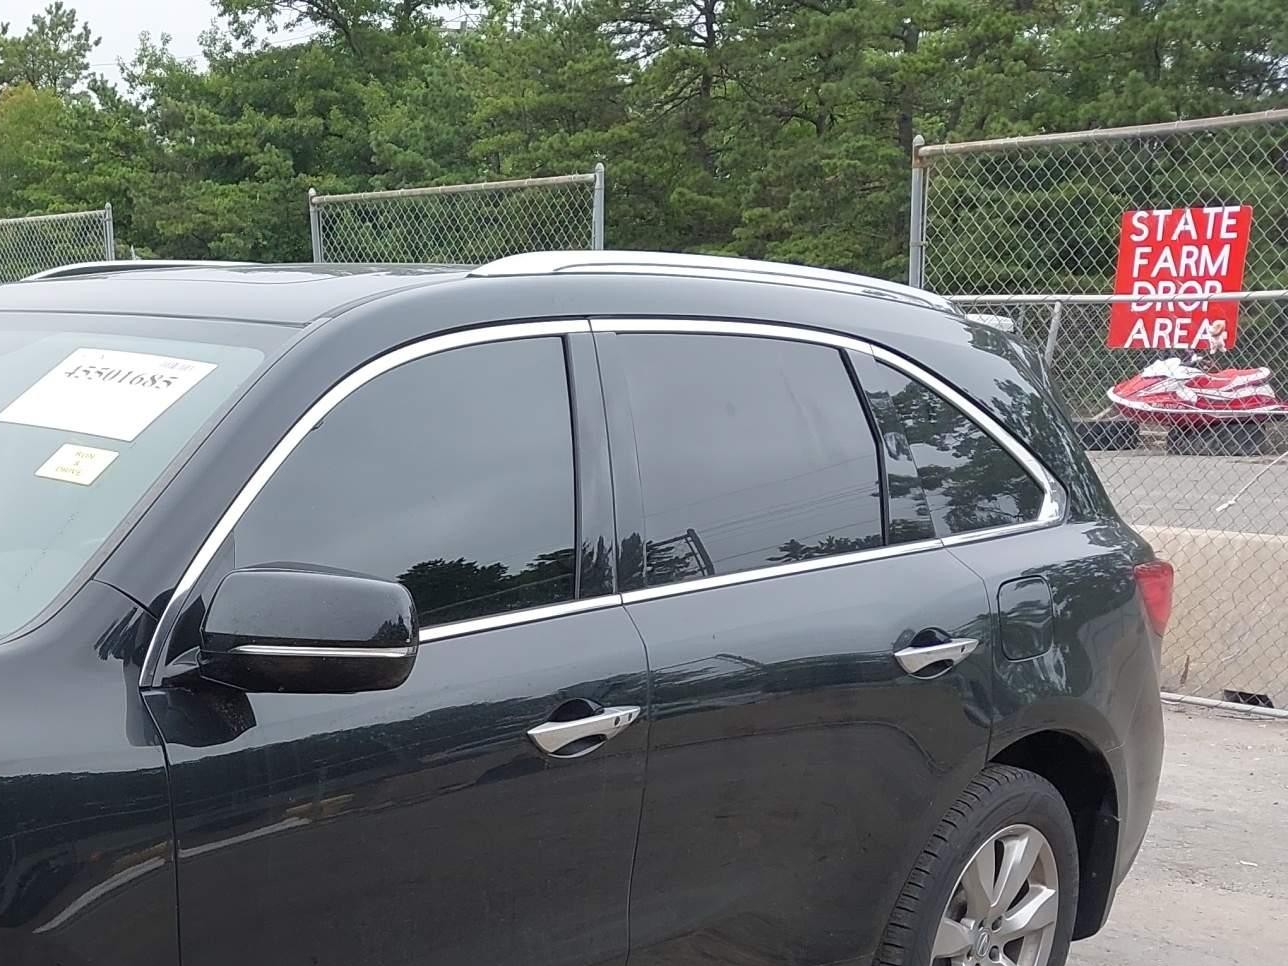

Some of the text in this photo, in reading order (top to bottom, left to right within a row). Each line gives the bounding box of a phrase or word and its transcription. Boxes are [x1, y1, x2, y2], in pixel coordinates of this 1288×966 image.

[1130, 206, 1241, 242] STATE
[1131, 244, 1231, 278] FARM
[1130, 280, 1223, 313] DROP
[1123, 318, 1214, 349] AREA
[64, 365, 179, 389] 45501685
